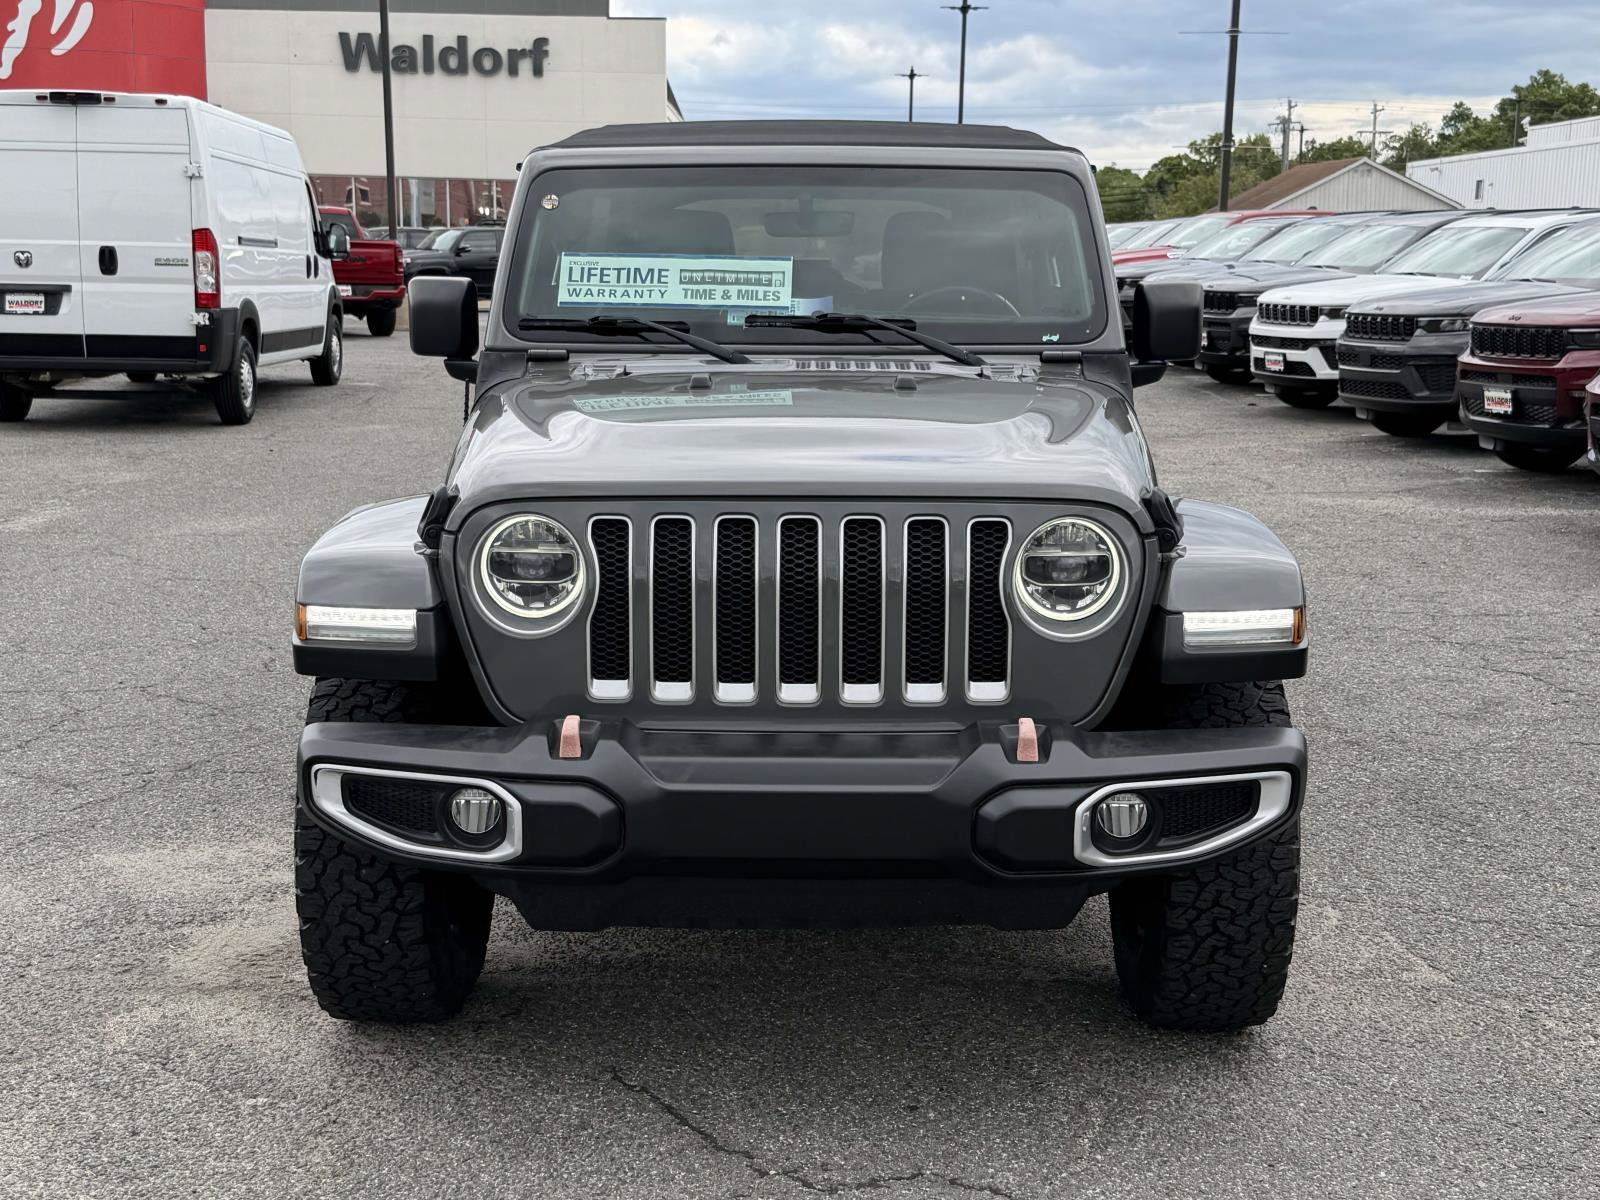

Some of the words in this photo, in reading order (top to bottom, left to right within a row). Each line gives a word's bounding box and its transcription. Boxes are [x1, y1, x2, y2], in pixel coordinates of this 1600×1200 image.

[338, 32, 549, 77] Waldorf
[567, 266, 670, 285] LIFETIME
[680, 270, 784, 287] UNLIMITED
[567, 288, 668, 299] WARRANTY
[682, 288, 717, 300] TIME
[721, 289, 732, 301] &
[737, 289, 781, 302] MILES
